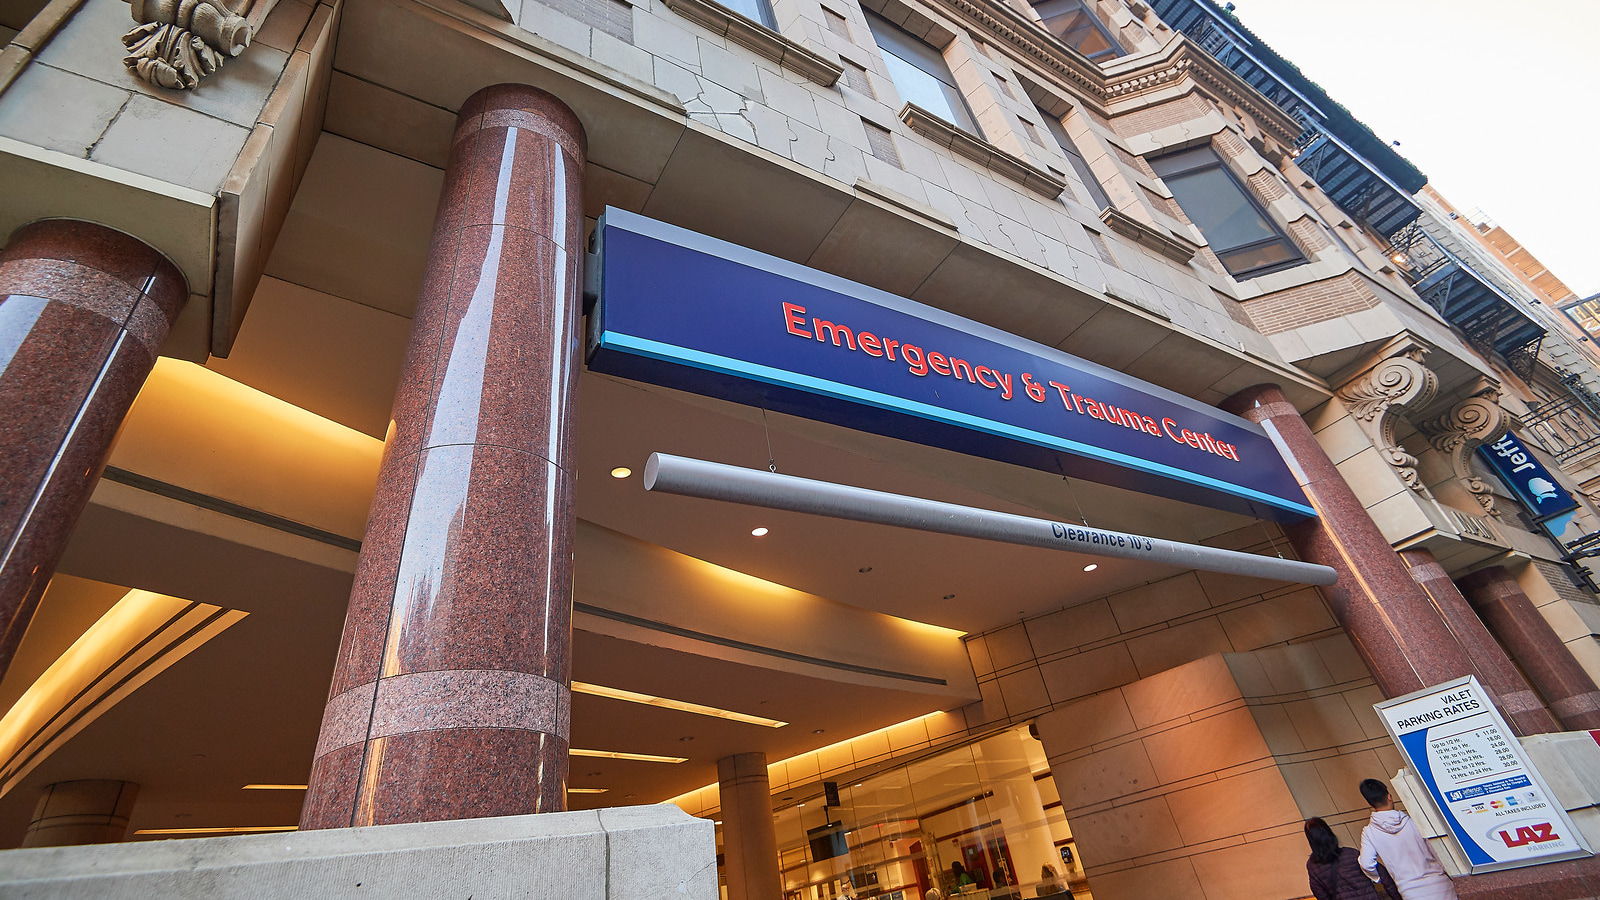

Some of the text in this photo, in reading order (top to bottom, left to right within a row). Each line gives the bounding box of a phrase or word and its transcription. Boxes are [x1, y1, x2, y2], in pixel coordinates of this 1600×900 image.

[782, 301, 1240, 462] Emergency & Trauma Center
[1051, 522, 1125, 548] Clearance
[1440, 689, 1472, 704] VALET
[1397, 699, 1480, 730] PARKING RATES
[1520, 803, 1546, 811] INCLUDED
[1498, 822, 1560, 848] LAZ
[1527, 841, 1565, 852] PARKING
